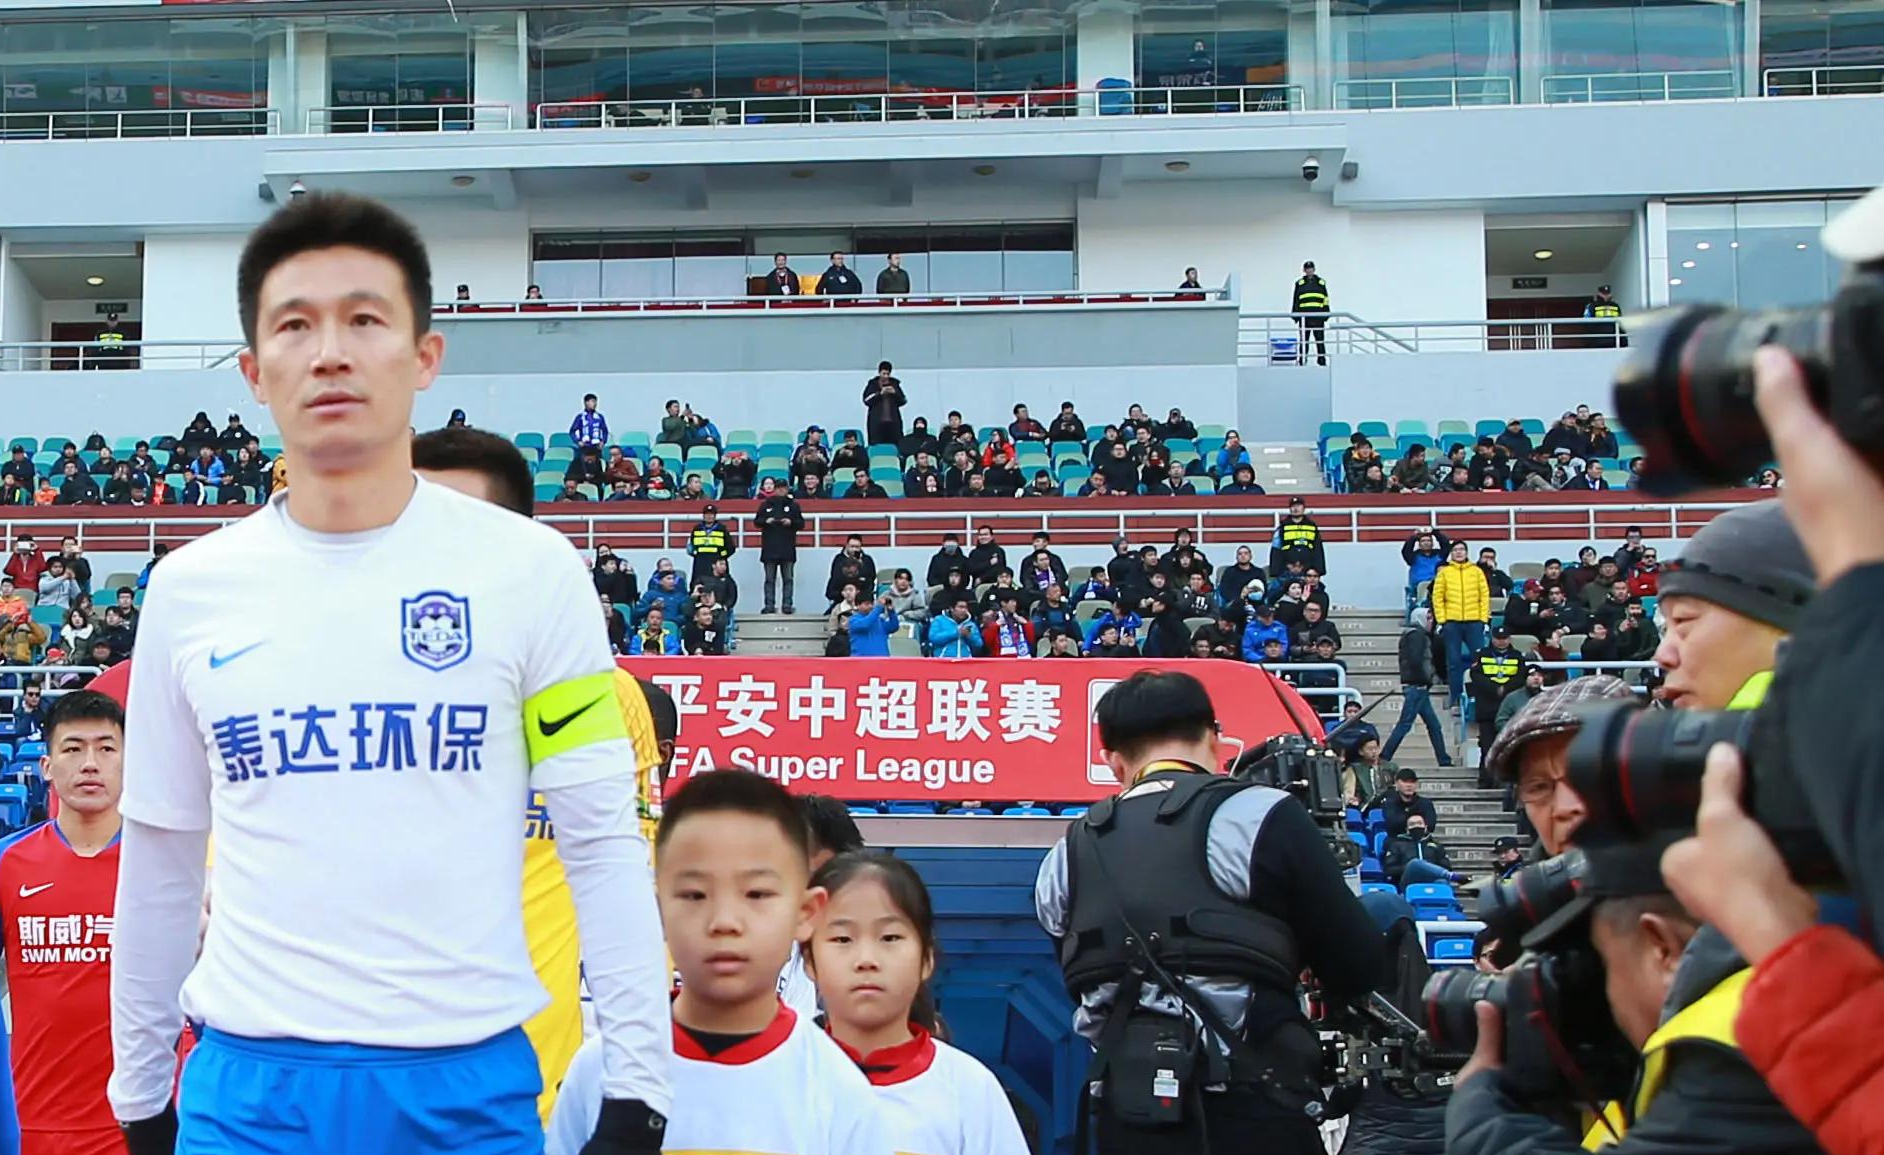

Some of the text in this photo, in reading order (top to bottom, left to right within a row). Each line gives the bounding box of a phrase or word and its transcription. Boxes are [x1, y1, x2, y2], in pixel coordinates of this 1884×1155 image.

[408, 630, 465, 642] TEDA
[652, 674, 1062, 744] 平安中超联赛
[212, 703, 488, 783] 泰达环保
[667, 747, 996, 788] FA Super League
[17, 914, 115, 946] 斯威汽
[21, 947, 115, 963] SWM MOT
